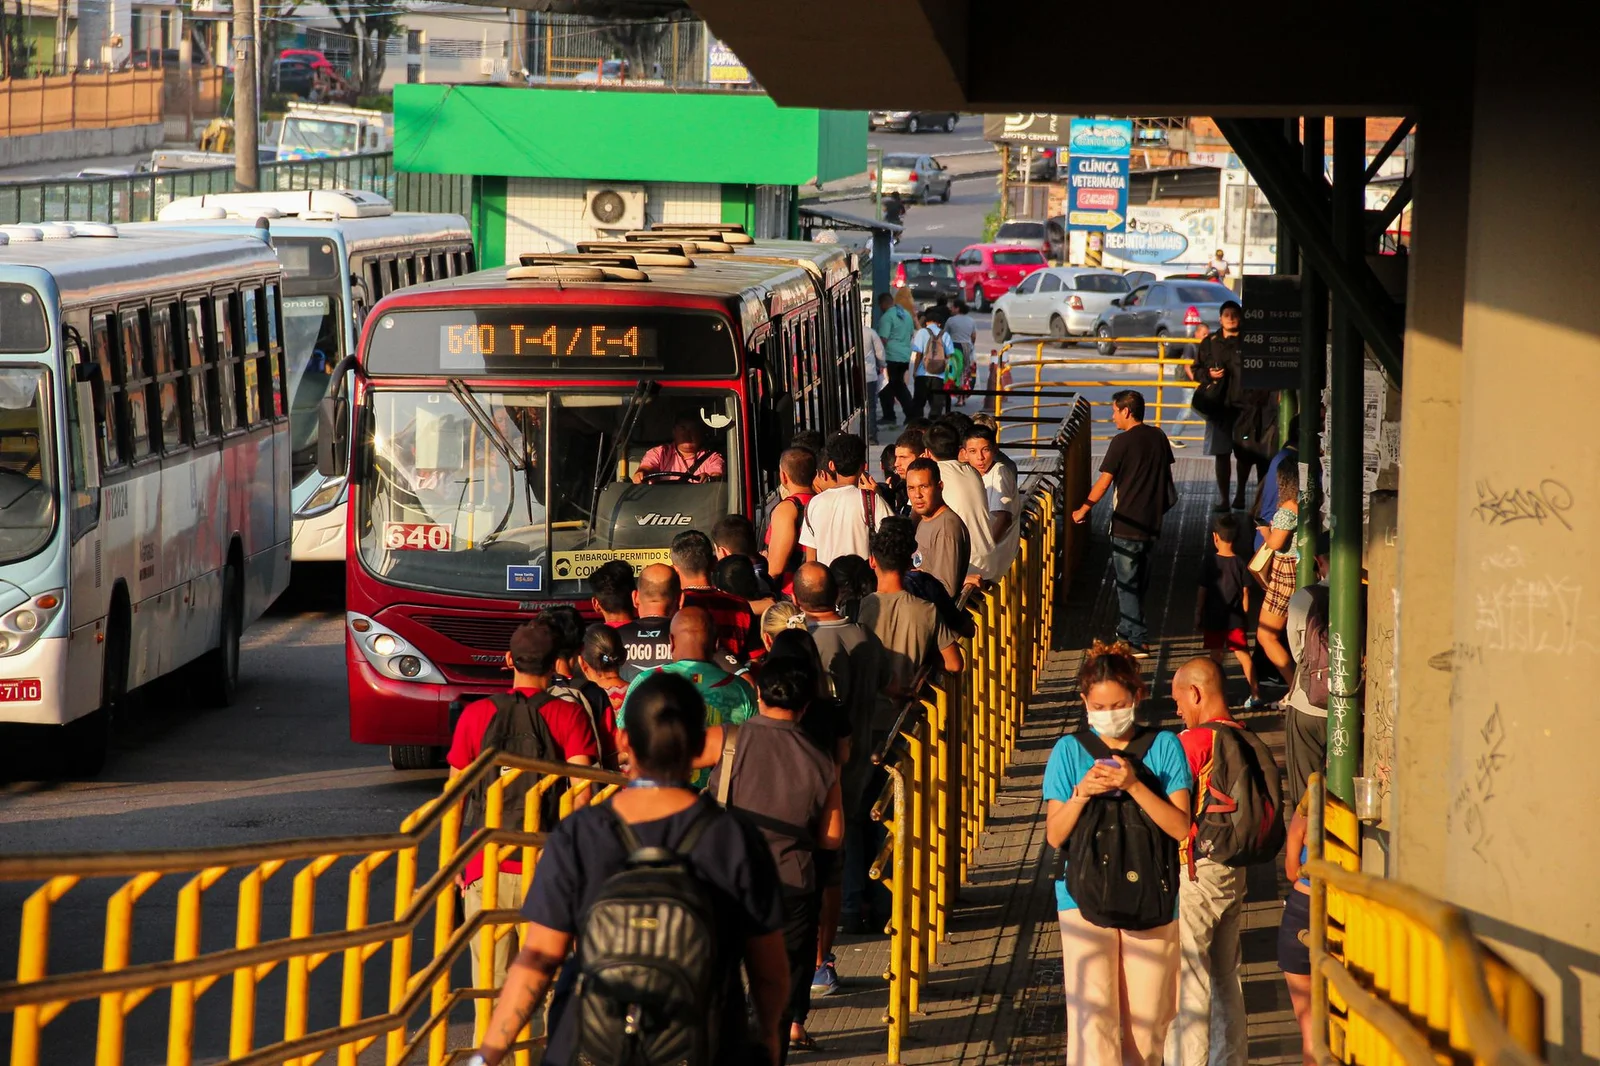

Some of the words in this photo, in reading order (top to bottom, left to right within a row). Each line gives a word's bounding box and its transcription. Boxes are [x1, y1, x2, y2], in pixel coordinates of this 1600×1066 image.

[1079, 158, 1120, 173] CLÍNICA
[1072, 174, 1126, 189] VETERINÁRIA
[1106, 233, 1145, 249] RECANTO
[1147, 235, 1182, 250] ANIMAIS
[1244, 309, 1264, 319] 640
[448, 324, 495, 354] 640
[510, 324, 557, 355] T-4
[566, 327, 582, 355] /
[591, 325, 638, 356] E-4
[1243, 334, 1264, 344] 448
[1243, 358, 1264, 369] 300
[635, 513, 693, 526] Viale
[386, 524, 449, 549] 640
[574, 552, 618, 562] EMBARQUE
[620, 551, 661, 561] PERMITIDO
